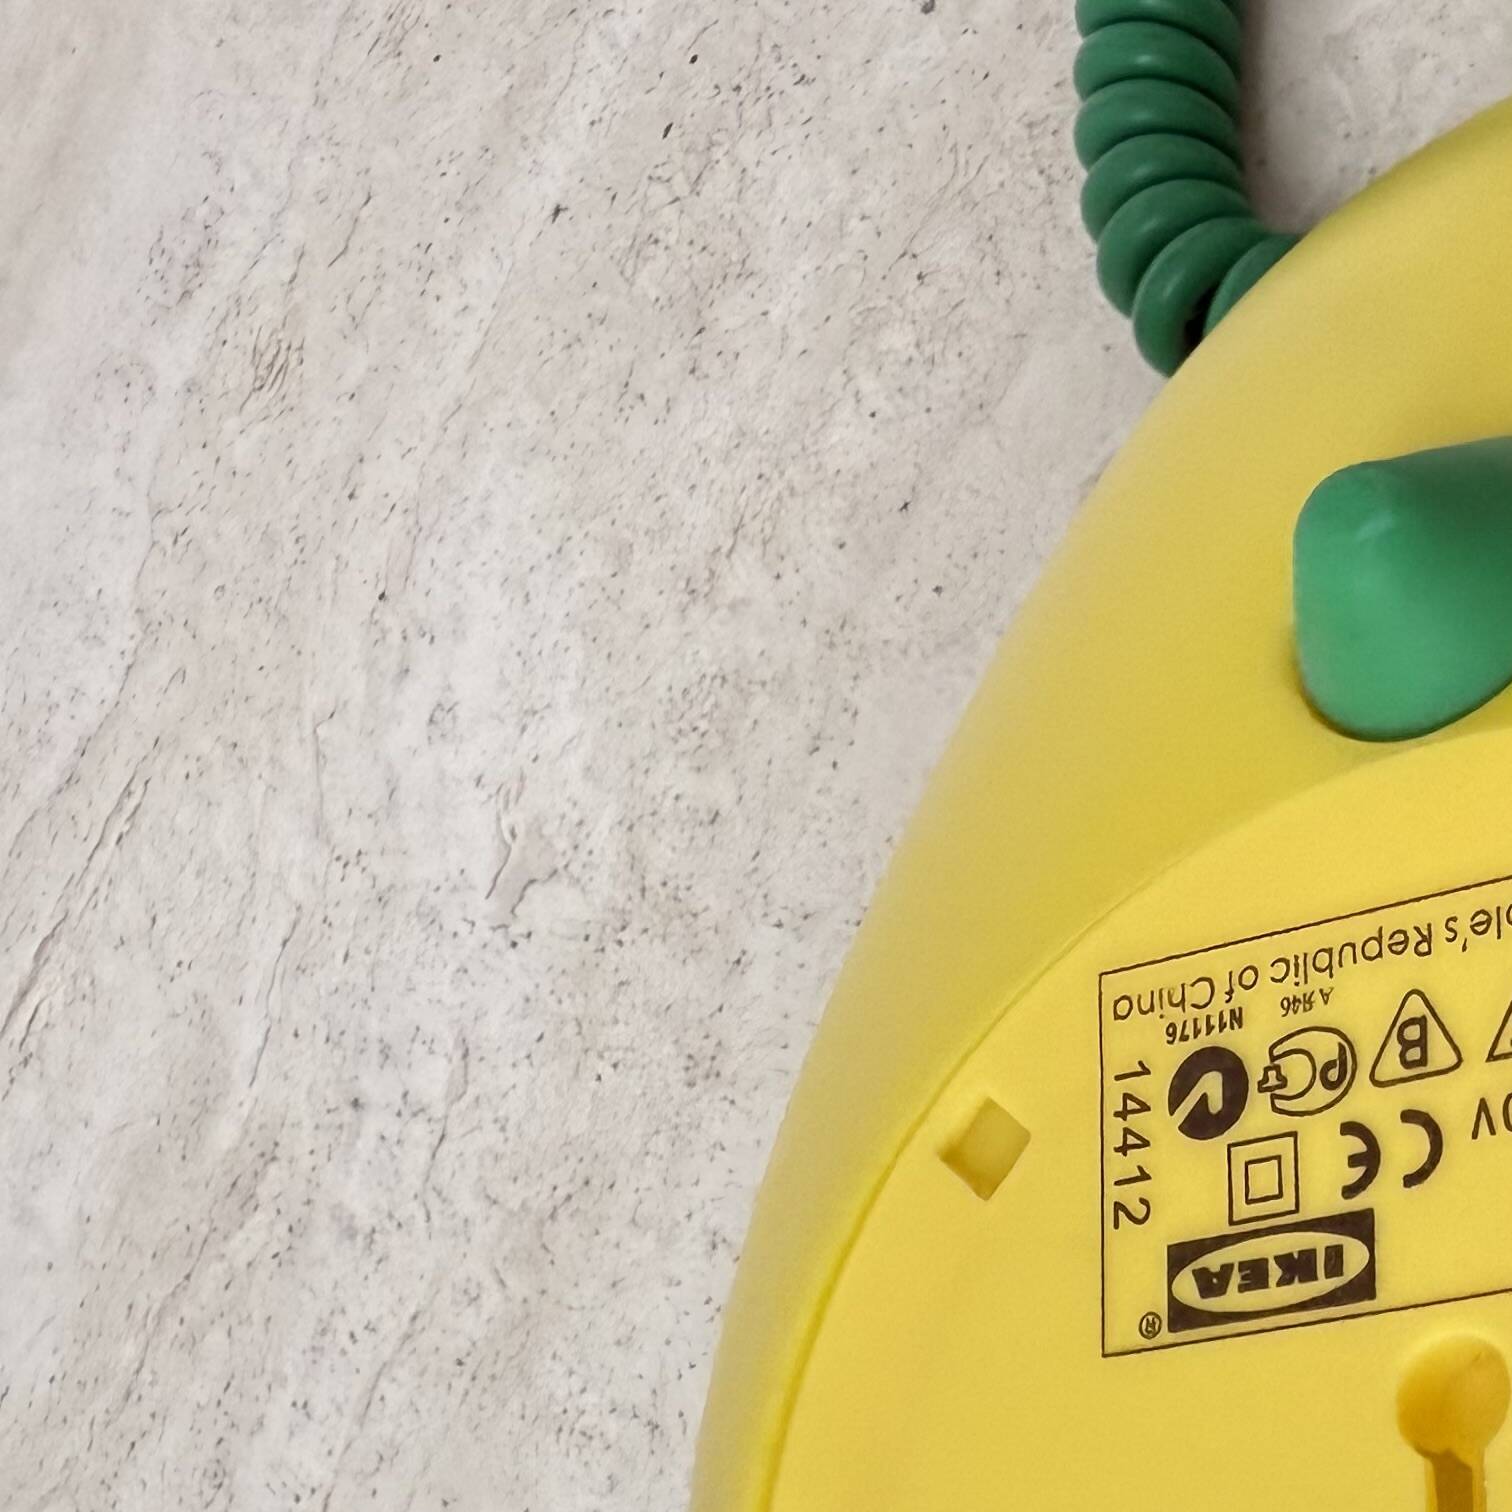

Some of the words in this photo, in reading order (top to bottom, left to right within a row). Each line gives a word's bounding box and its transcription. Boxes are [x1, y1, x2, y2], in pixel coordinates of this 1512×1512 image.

[1269, 921, 1433, 986] Republic
[1112, 975, 1216, 1022] China
[1223, 964, 1260, 1005] of
[1164, 1005, 1244, 1046] N11176
[1112, 1059, 1153, 1232] 14412
[1339, 1108, 1445, 1201] CE
[1191, 1243, 1345, 1300] IKEA
